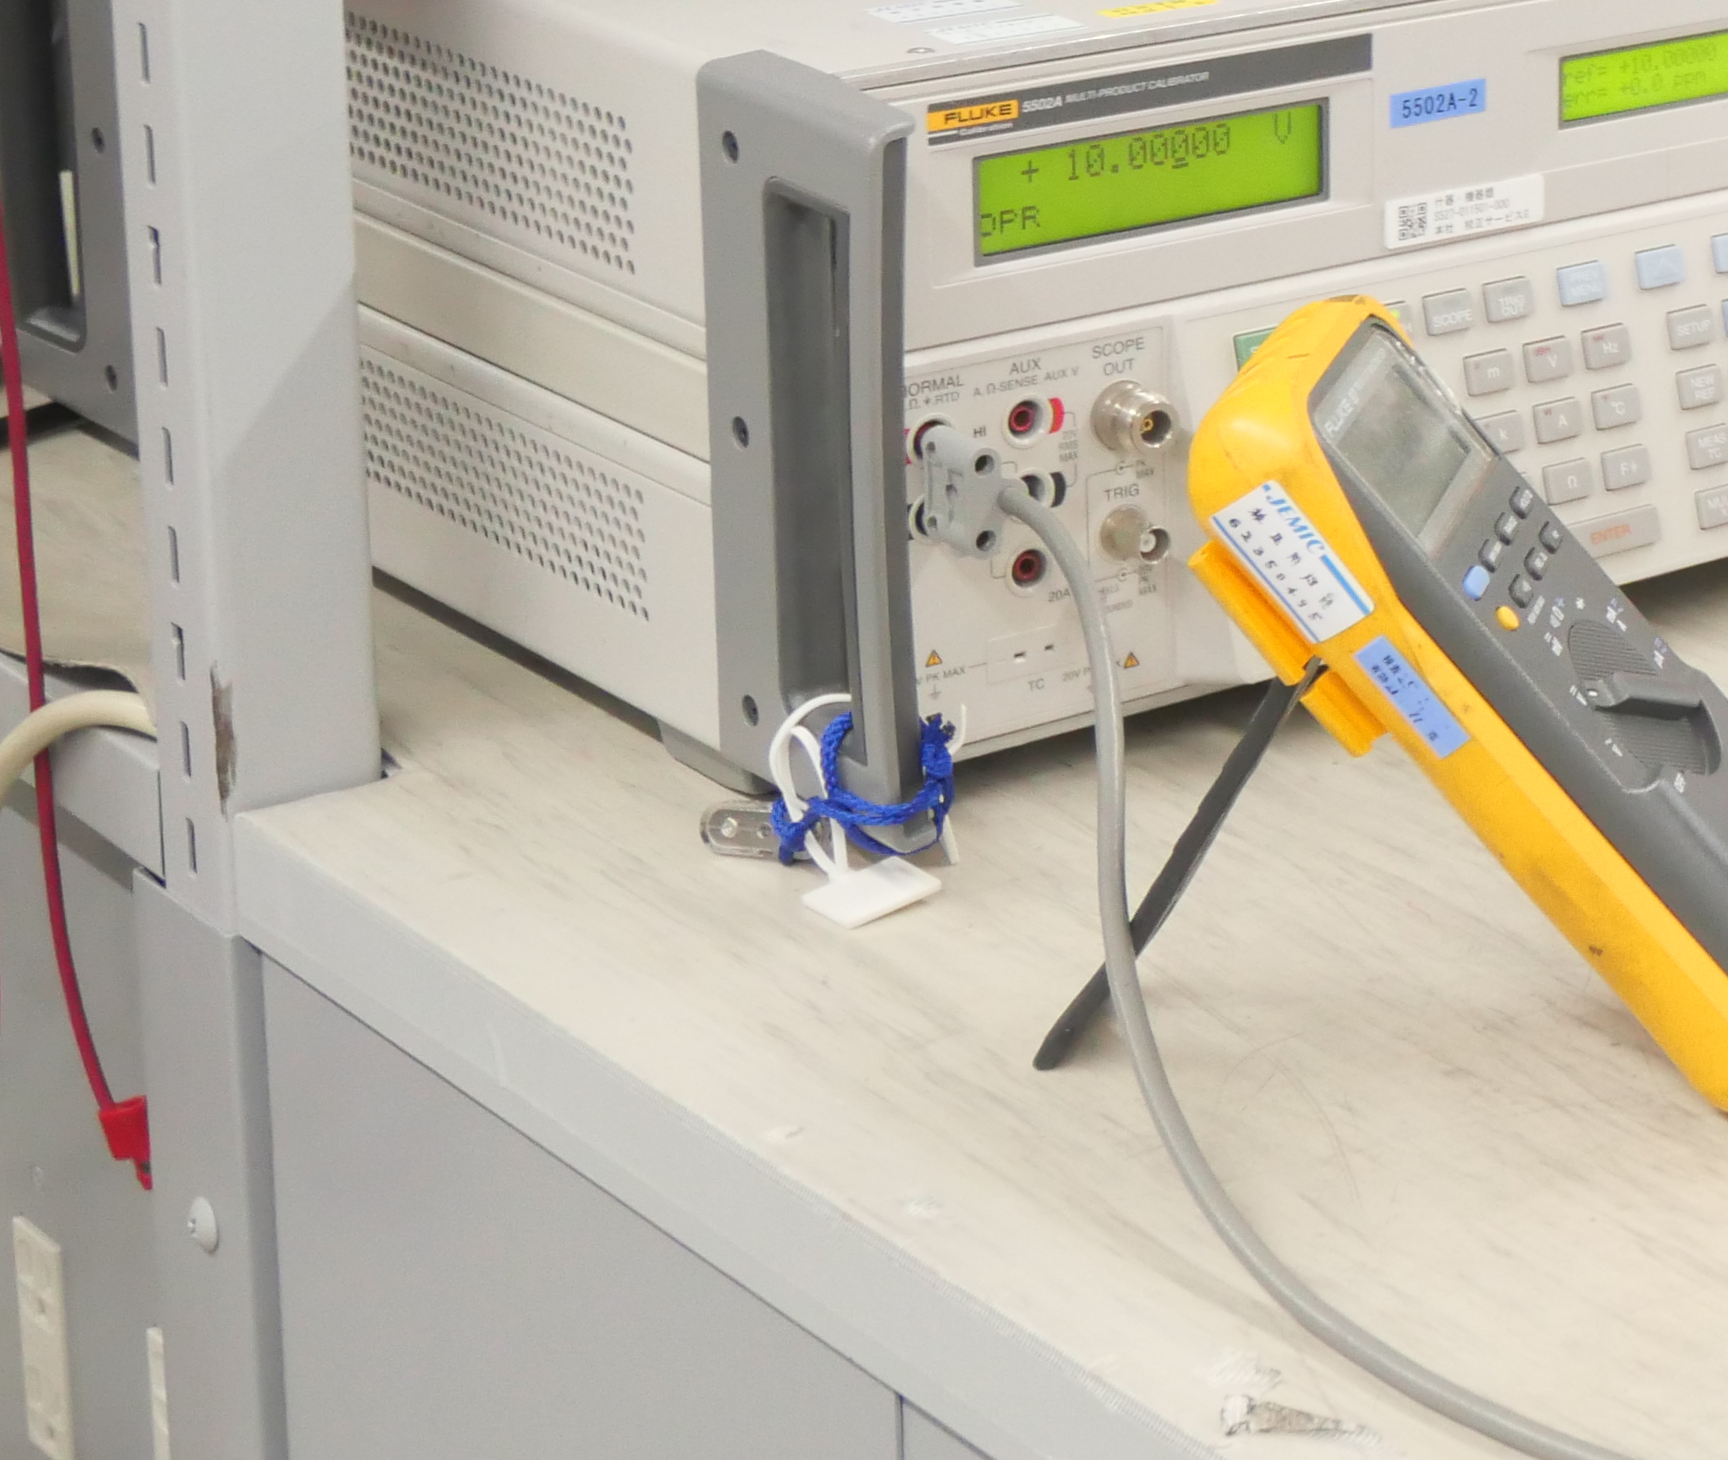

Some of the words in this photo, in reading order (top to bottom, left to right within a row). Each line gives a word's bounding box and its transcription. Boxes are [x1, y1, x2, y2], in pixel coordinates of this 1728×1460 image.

[1021, 94, 1064, 114] 5502A
[1147, 70, 1211, 91] CALIBRATOR
[1402, 87, 1479, 120] 5502A-2
[943, 103, 1014, 126] FLUKE
[958, 122, 1014, 136] Calibration
[1067, 122, 1231, 182] 10.00000
[1502, 303, 1525, 317] OUT
[1432, 309, 1474, 328] SCOPE
[1676, 319, 1712, 337] SETUP
[1091, 336, 1145, 360] SCOPE
[1602, 341, 1619, 355] Hz
[1009, 357, 1042, 376] AUX
[1102, 358, 1136, 377] OUT
[1548, 354, 1558, 368] V
[1043, 369, 1069, 383] AUX
[1690, 374, 1715, 388] NEW
[1694, 386, 1715, 400] REF
[1558, 414, 1568, 429] A
[973, 426, 988, 439] HI
[1698, 432, 1727, 448] MEAS
[1059, 451, 1080, 463] MAX
[1103, 483, 1141, 502] TRIG
[1265, 493, 1327, 555] JEMIC
[1589, 524, 1632, 545] ENTER
[1047, 588, 1072, 603] 20A
[942, 665, 966, 680] MAX
[1027, 678, 1046, 692] TC
